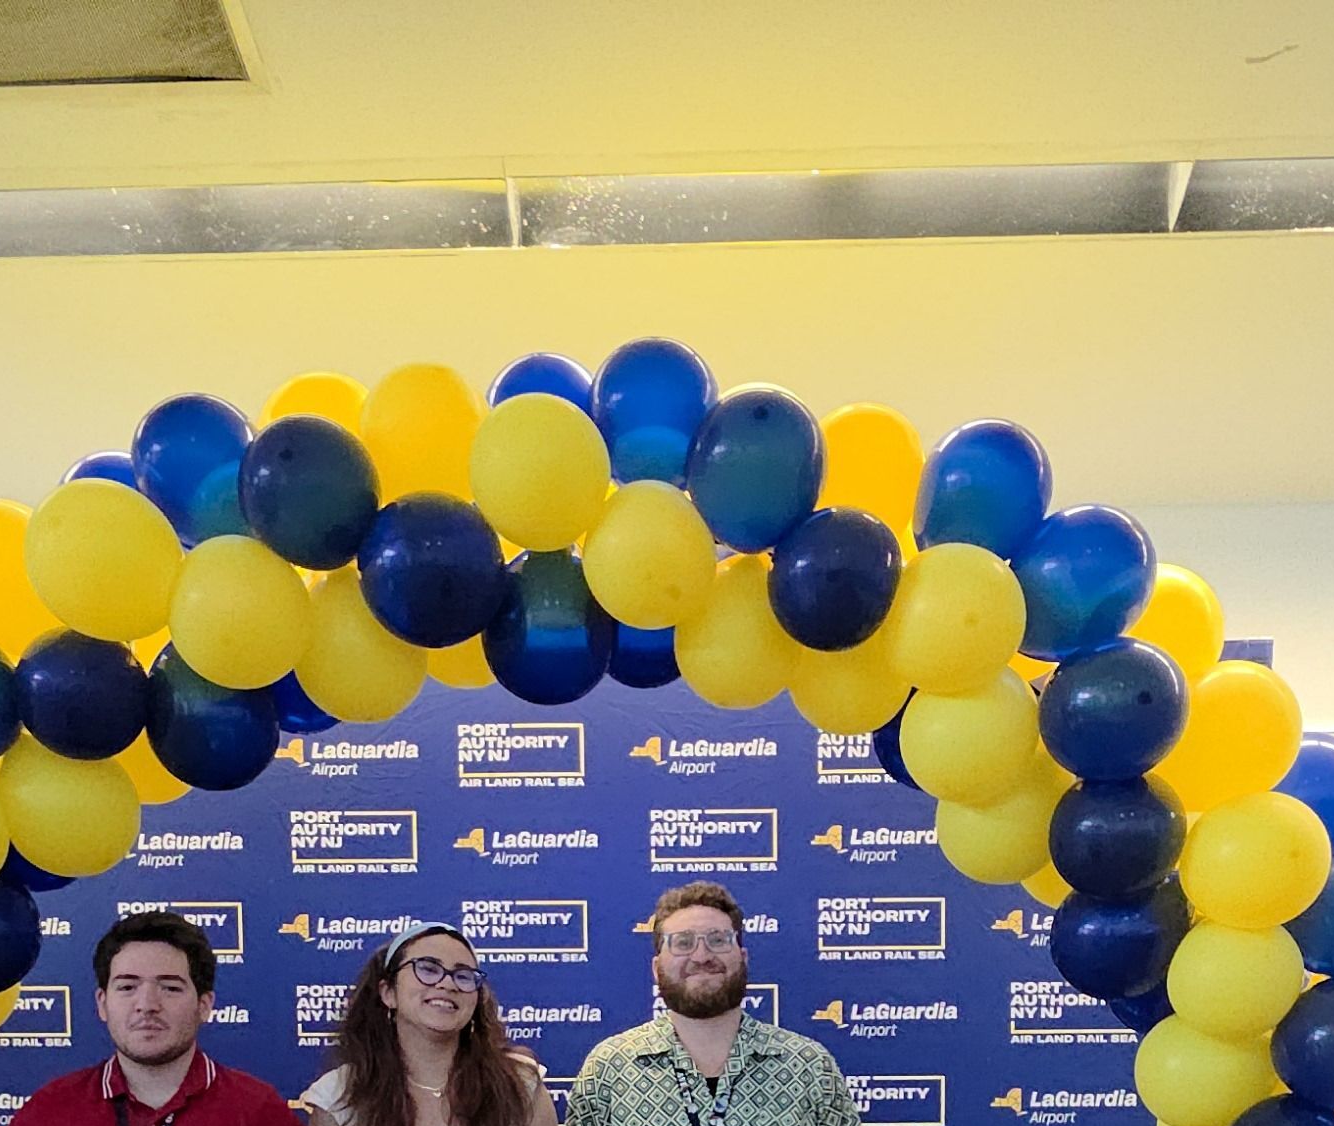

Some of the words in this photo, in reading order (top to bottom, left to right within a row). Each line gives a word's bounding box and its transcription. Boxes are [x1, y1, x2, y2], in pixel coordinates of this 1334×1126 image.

[458, 724, 510, 738] PORT
[312, 740, 418, 758] LaGuardia
[458, 735, 568, 750] AUTHORITY
[669, 738, 776, 757] LaGuardia
[459, 748, 485, 762] NY
[488, 749, 509, 761] NJ
[312, 763, 358, 777] Airport
[669, 761, 716, 776] Airport
[459, 776, 482, 787] AIR
[485, 776, 521, 787] LAND
[525, 776, 555, 786] RAIL
[558, 778, 584, 786] SEA
[137, 831, 243, 850] LaGuardia
[138, 853, 184, 868] Airport
[1030, 1089, 1139, 1107] LaGuardia
[1029, 1111, 1076, 1126] Airport
